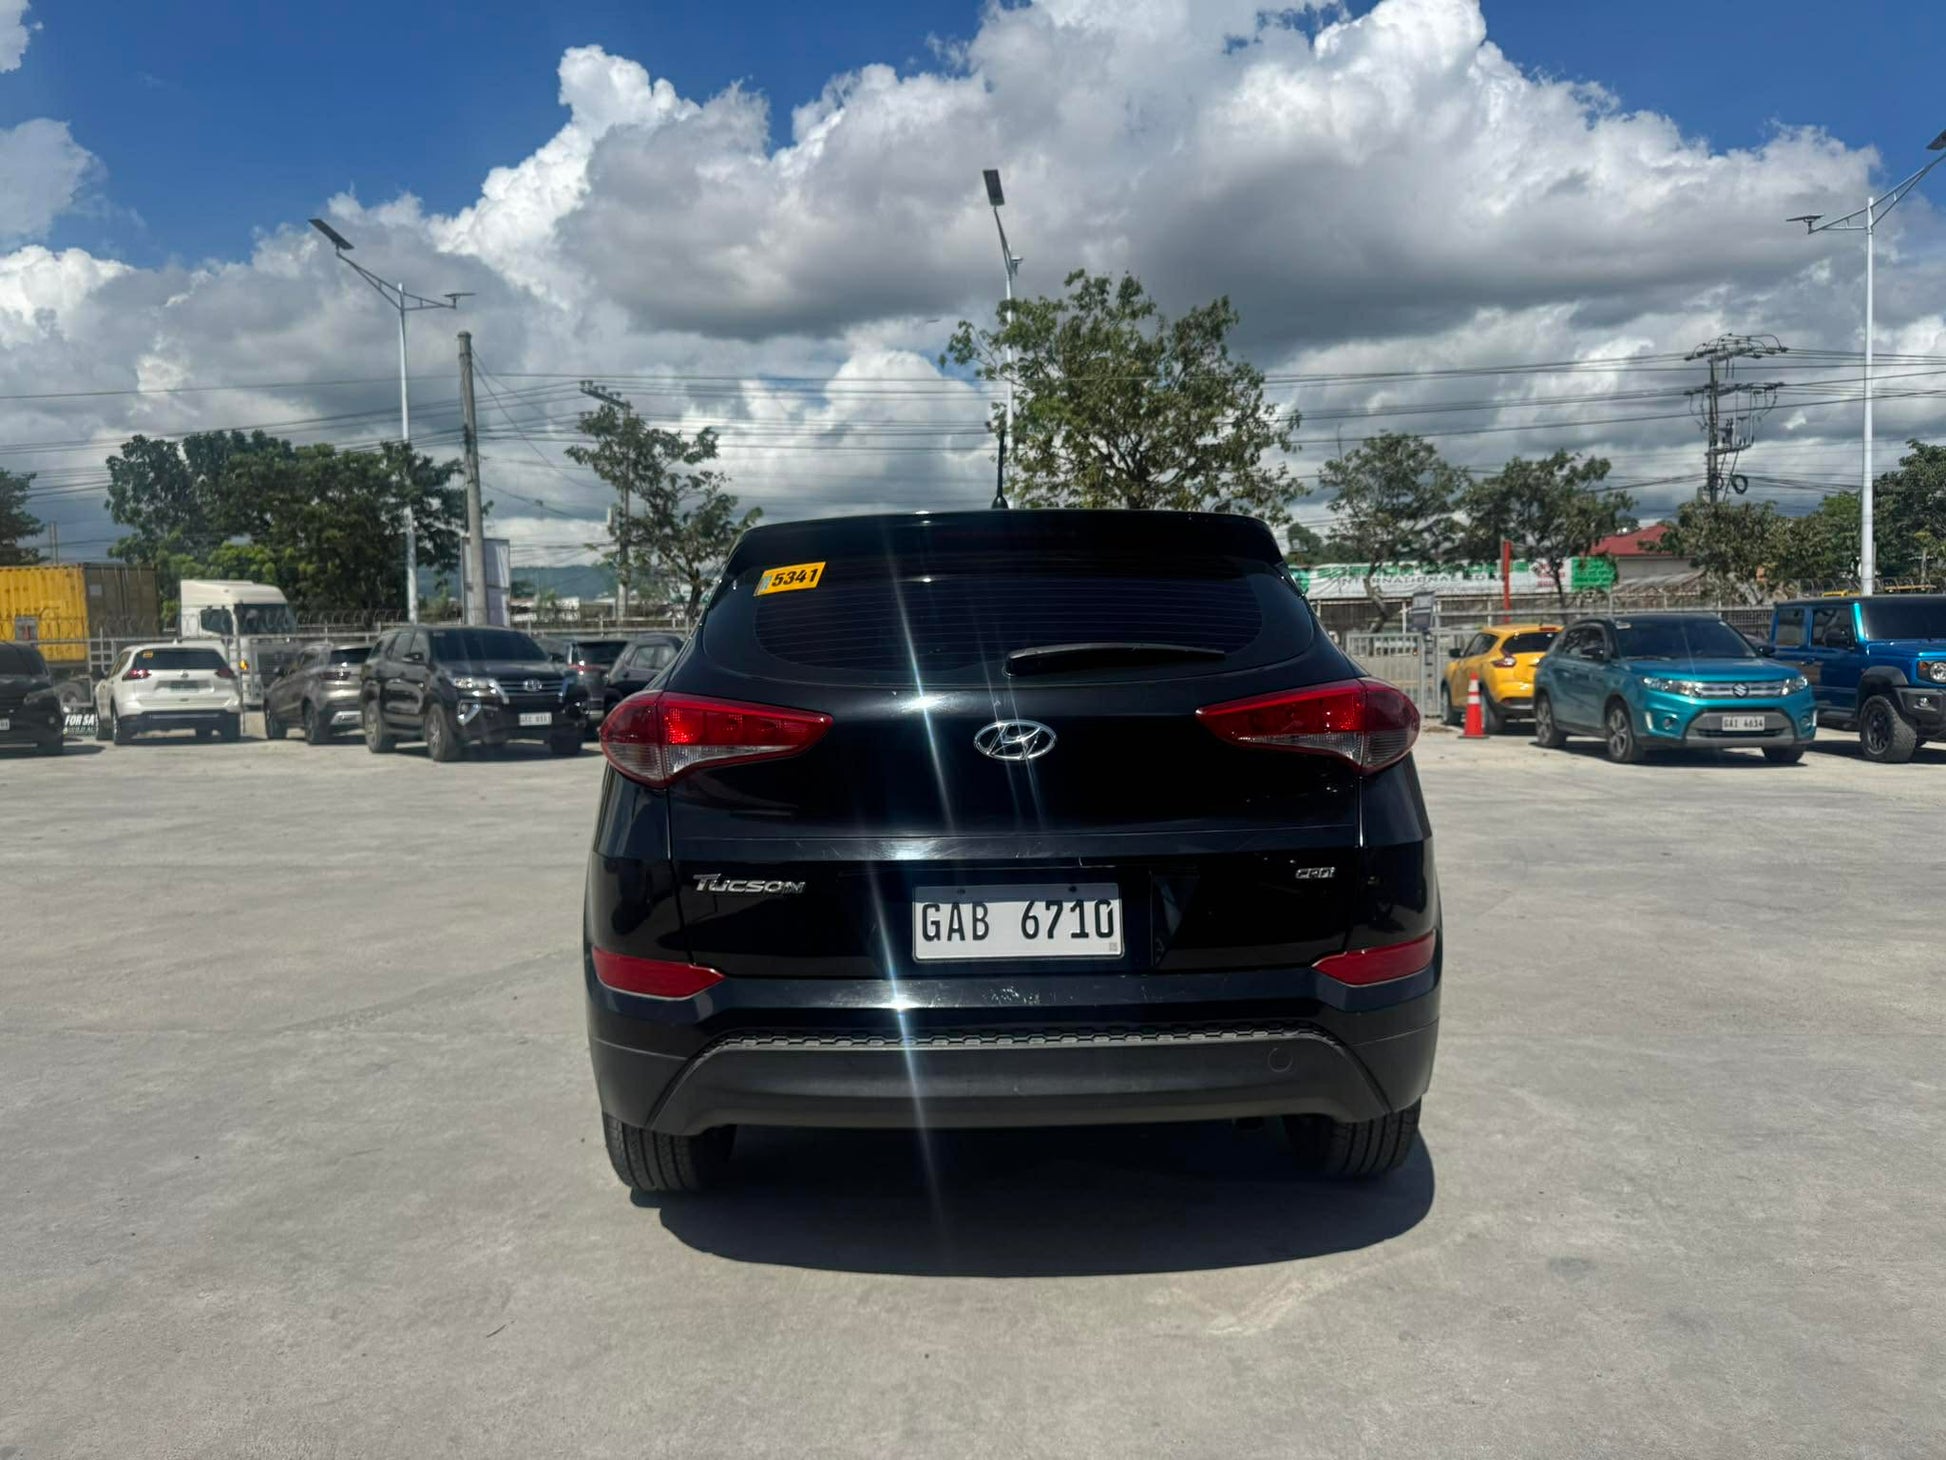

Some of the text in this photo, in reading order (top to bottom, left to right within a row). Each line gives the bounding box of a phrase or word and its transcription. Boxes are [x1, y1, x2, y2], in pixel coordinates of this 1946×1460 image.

[771, 568, 818, 587] 5341
[694, 873, 806, 894] TUCSON
[921, 899, 1115, 942] GAB 6710
